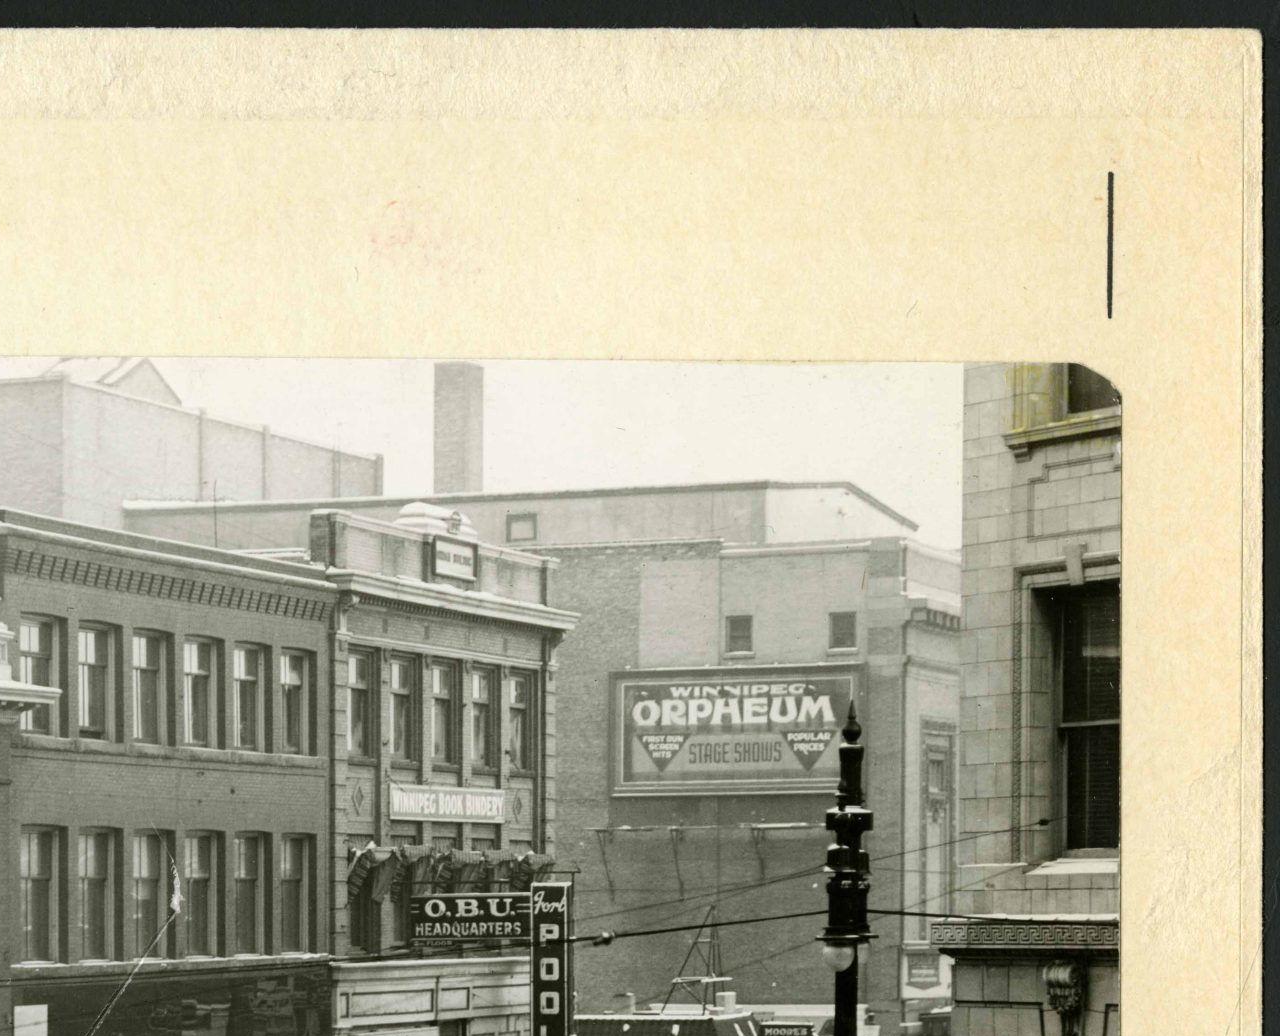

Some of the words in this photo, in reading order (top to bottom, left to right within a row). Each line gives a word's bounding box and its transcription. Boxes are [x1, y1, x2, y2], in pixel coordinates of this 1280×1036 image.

[670, 683, 806, 698] WINNIPEG
[632, 695, 836, 726] ORPHEUM
[787, 732, 831, 742] POPULAR
[688, 743, 730, 764] STAGE
[734, 741, 782, 763] SHOWS
[793, 743, 826, 755] PRICES
[439, 793, 464, 816] BOOK
[415, 921, 522, 938] HEADQUARTERS
